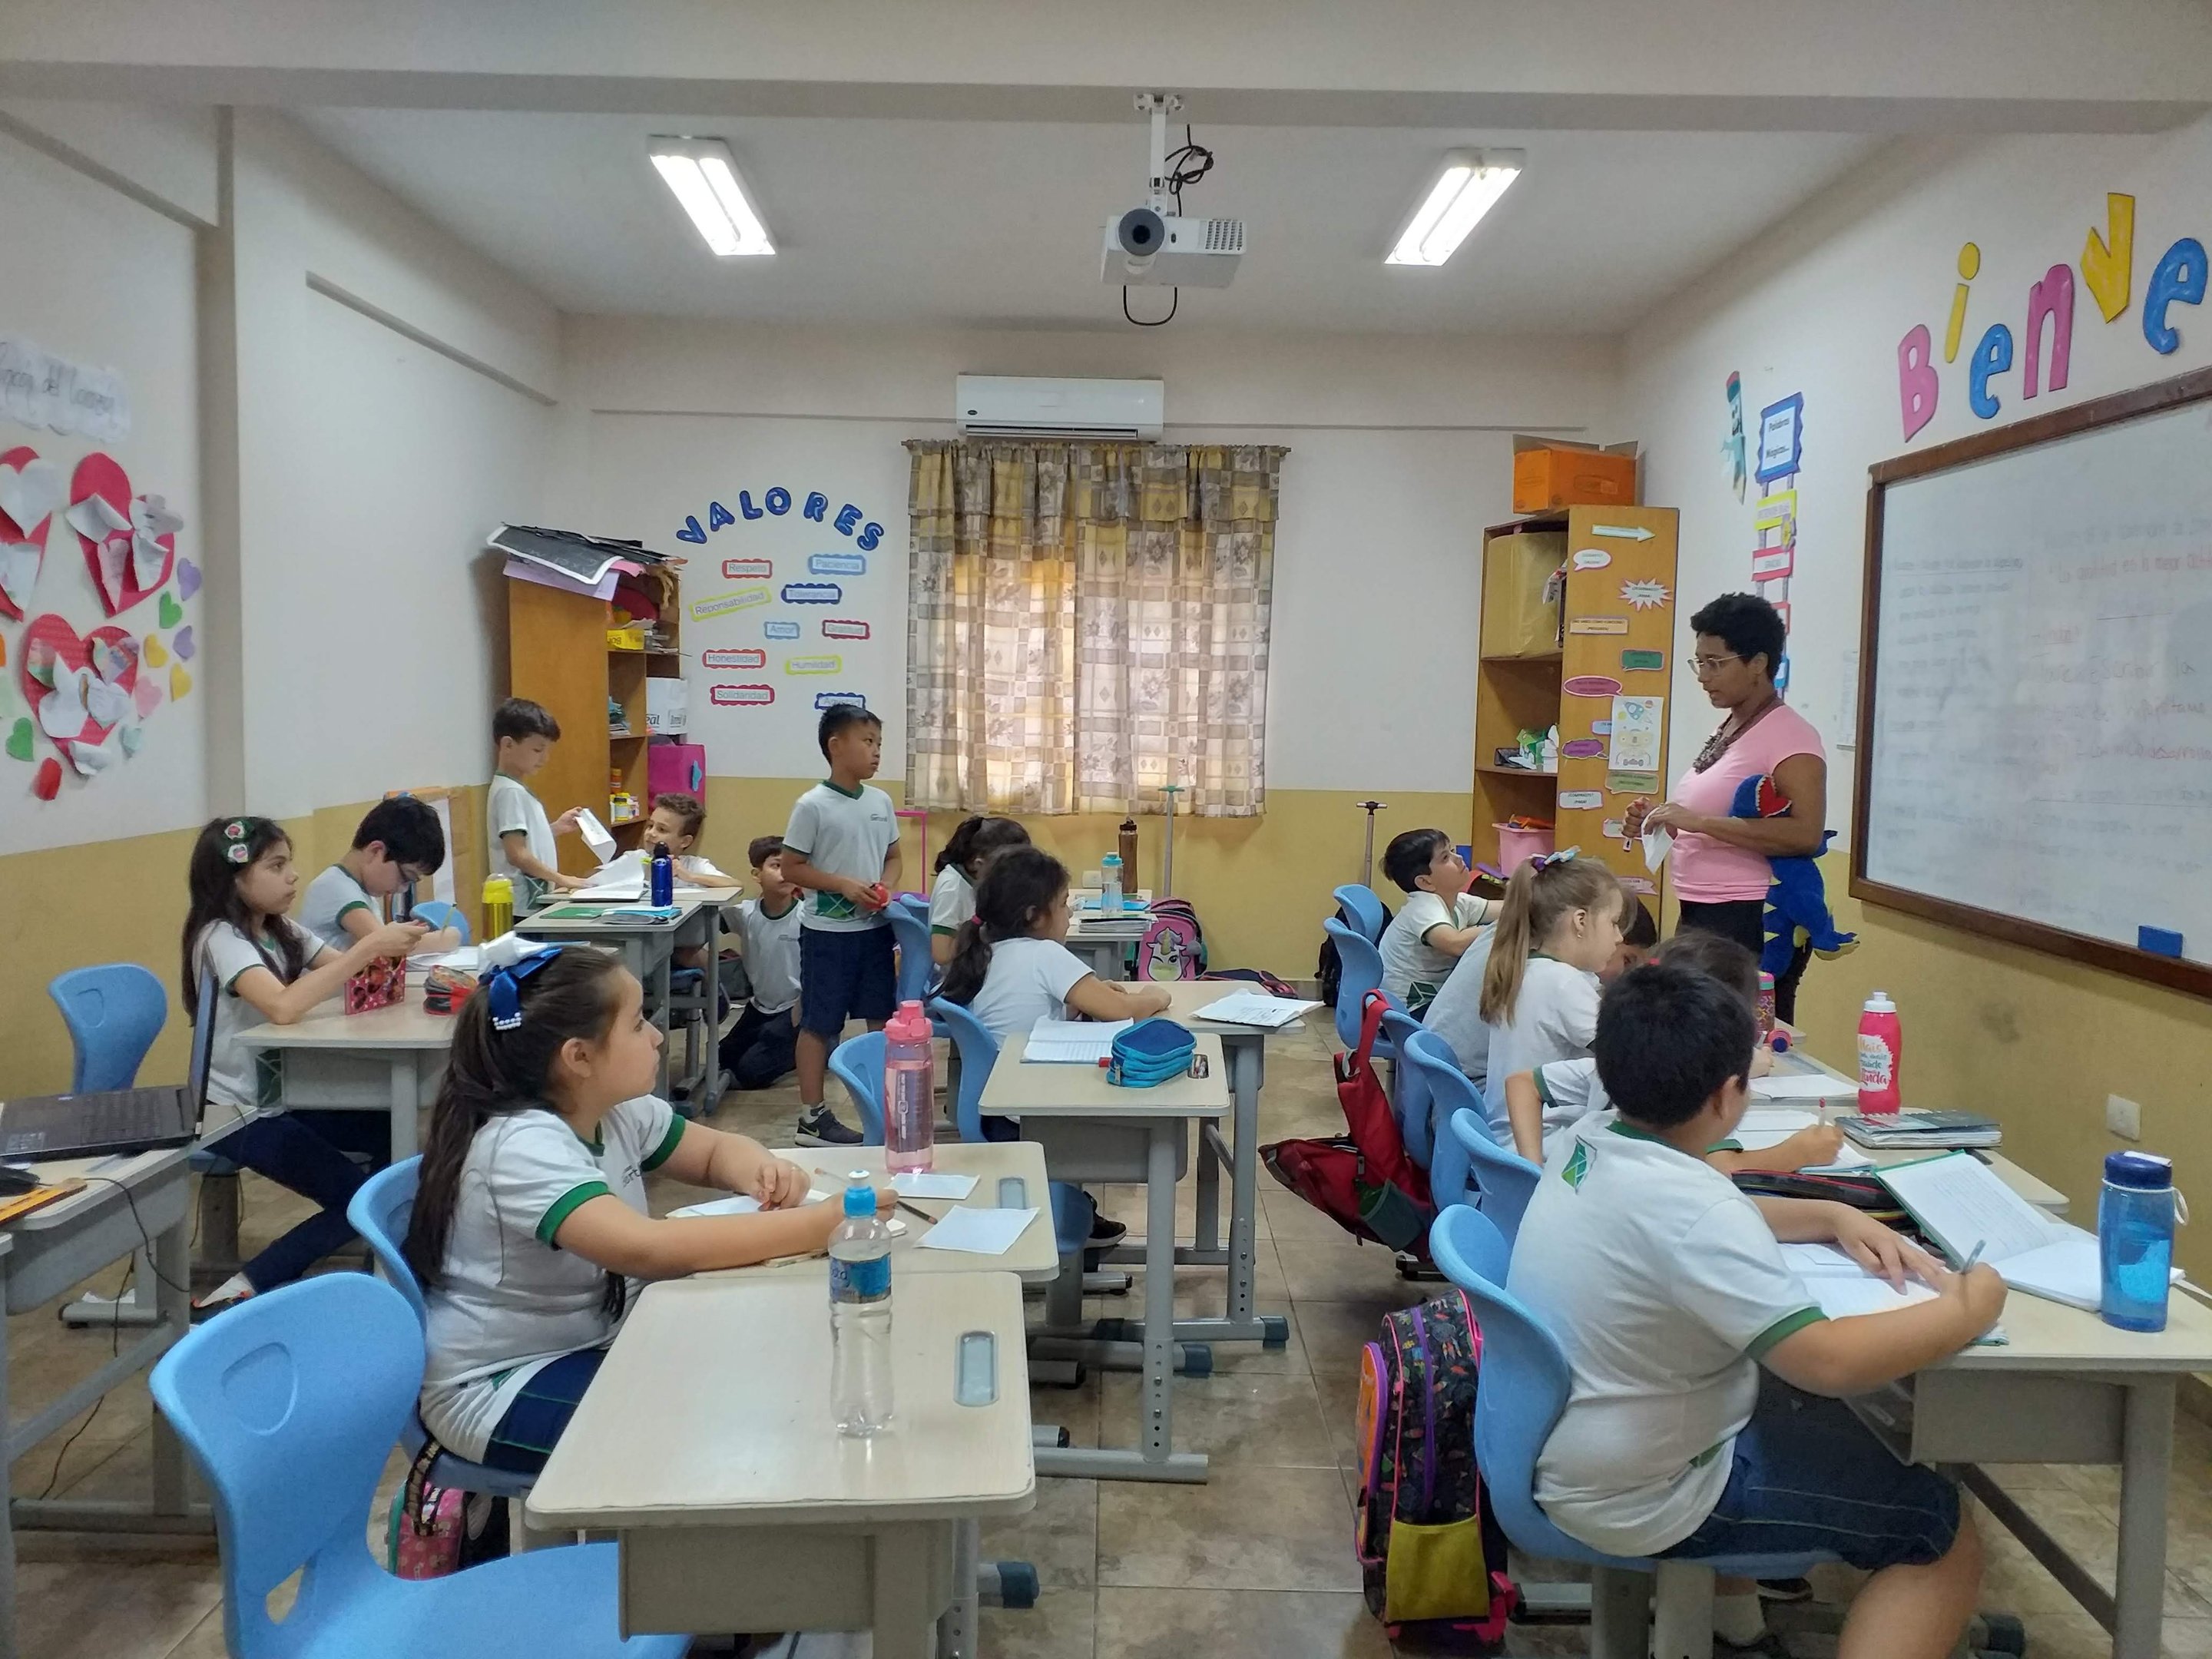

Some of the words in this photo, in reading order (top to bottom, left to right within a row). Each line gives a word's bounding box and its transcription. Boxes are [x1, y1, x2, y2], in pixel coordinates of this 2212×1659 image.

[676, 487, 885, 551] VALORES
[729, 563, 767, 574] Respeto
[815, 558, 860, 571] Paciencia
[770, 624, 796, 634] Amor
[707, 653, 760, 665] Honestidad
[791, 660, 836, 670] Humildad
[716, 689, 769, 700] Solidaridad
[1860, 1068, 1888, 1087] Linda
